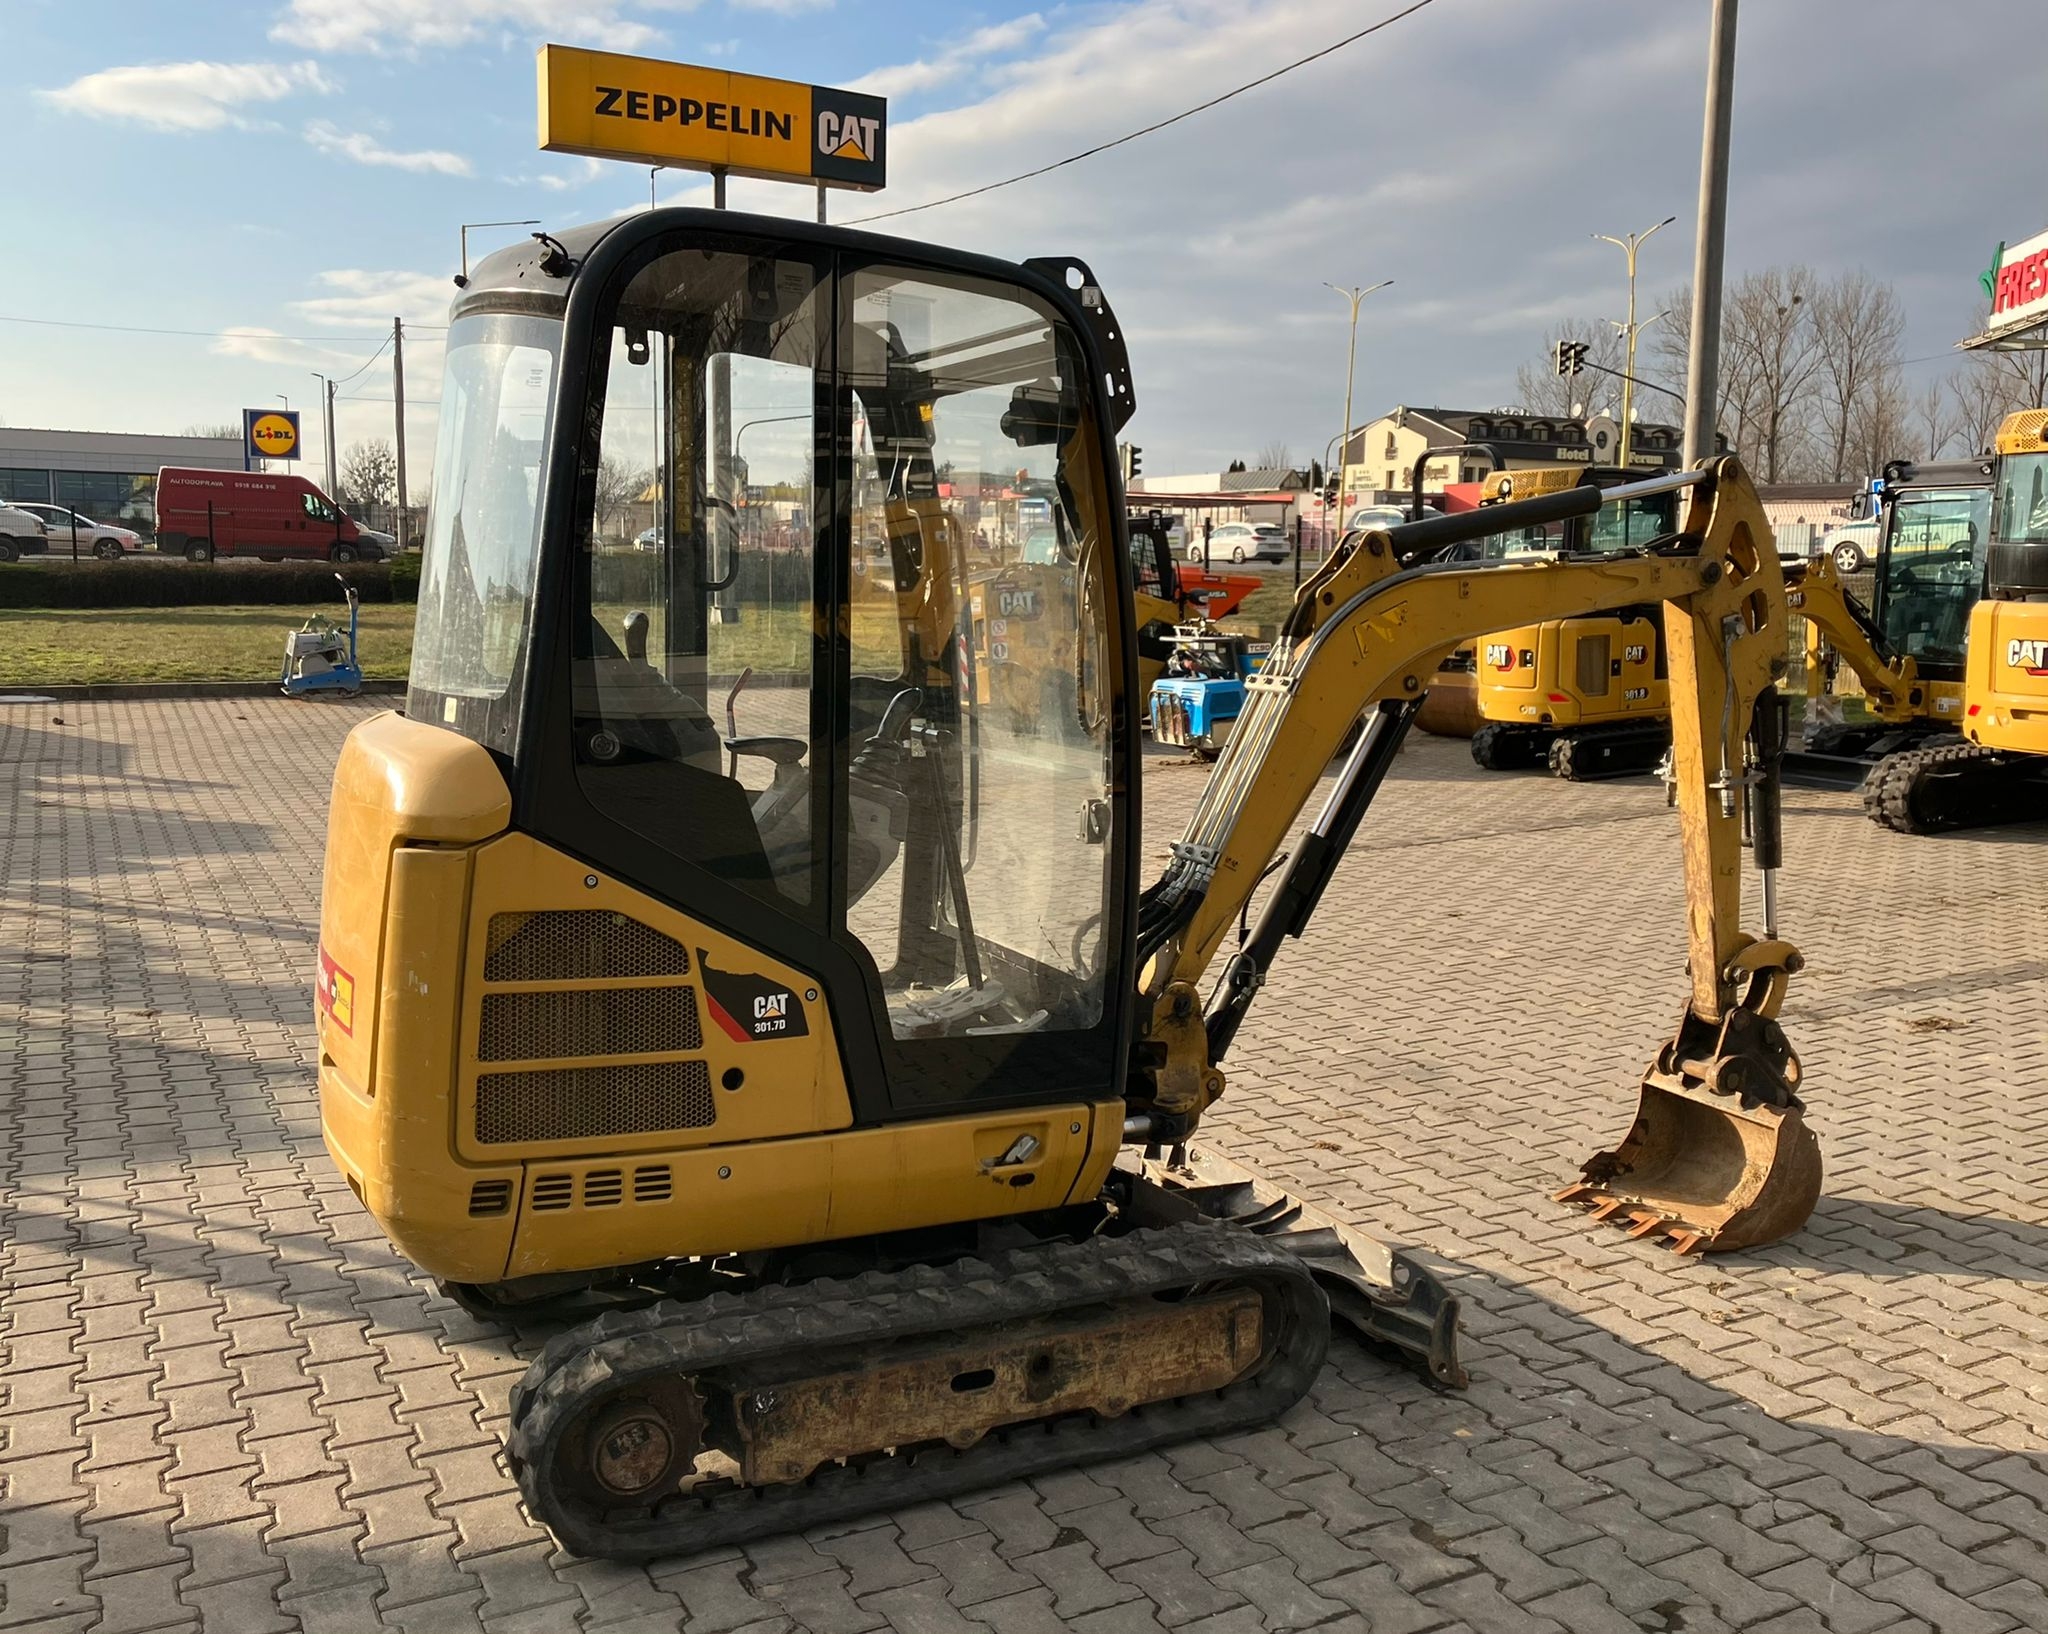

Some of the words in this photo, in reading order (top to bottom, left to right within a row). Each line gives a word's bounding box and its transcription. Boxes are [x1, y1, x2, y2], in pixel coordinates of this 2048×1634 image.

[595, 86, 792, 141] ZEPPELIN
[817, 110, 880, 163] CAT
[1556, 447, 1589, 461] Hotel
[170, 478, 224, 487] AUTODOPRAVA
[1000, 591, 1035, 616] CAT
[1786, 592, 1803, 607] CAT
[1487, 645, 1508, 666] CAT
[1625, 646, 1644, 662] CAT
[2007, 639, 2048, 668] CAT
[1624, 688, 1645, 700] 301.8
[753, 993, 789, 1019] CAT
[754, 1019, 786, 1033] 301.7D
